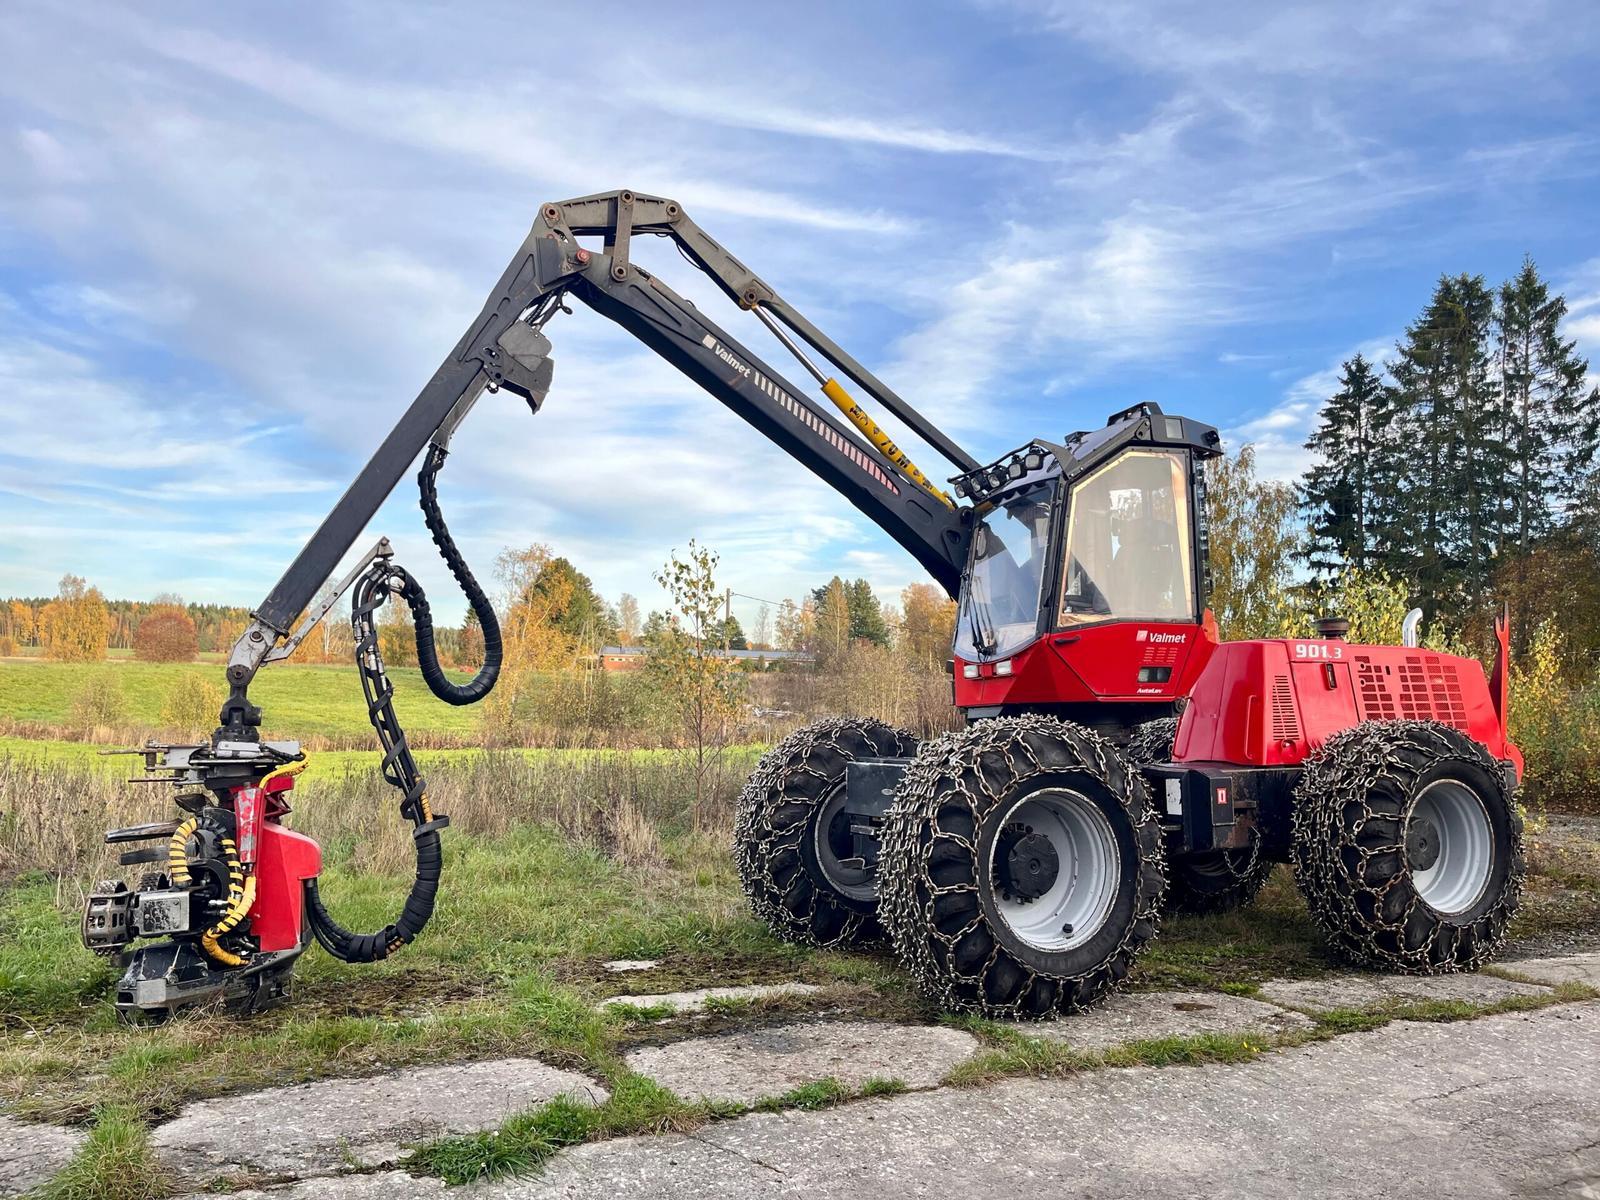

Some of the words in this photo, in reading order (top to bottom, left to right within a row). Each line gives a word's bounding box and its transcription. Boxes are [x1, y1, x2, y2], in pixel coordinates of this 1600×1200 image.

[714, 345, 751, 378] Valmet
[1150, 632, 1187, 644] Valmet
[1136, 687, 1163, 695] AutoLev
